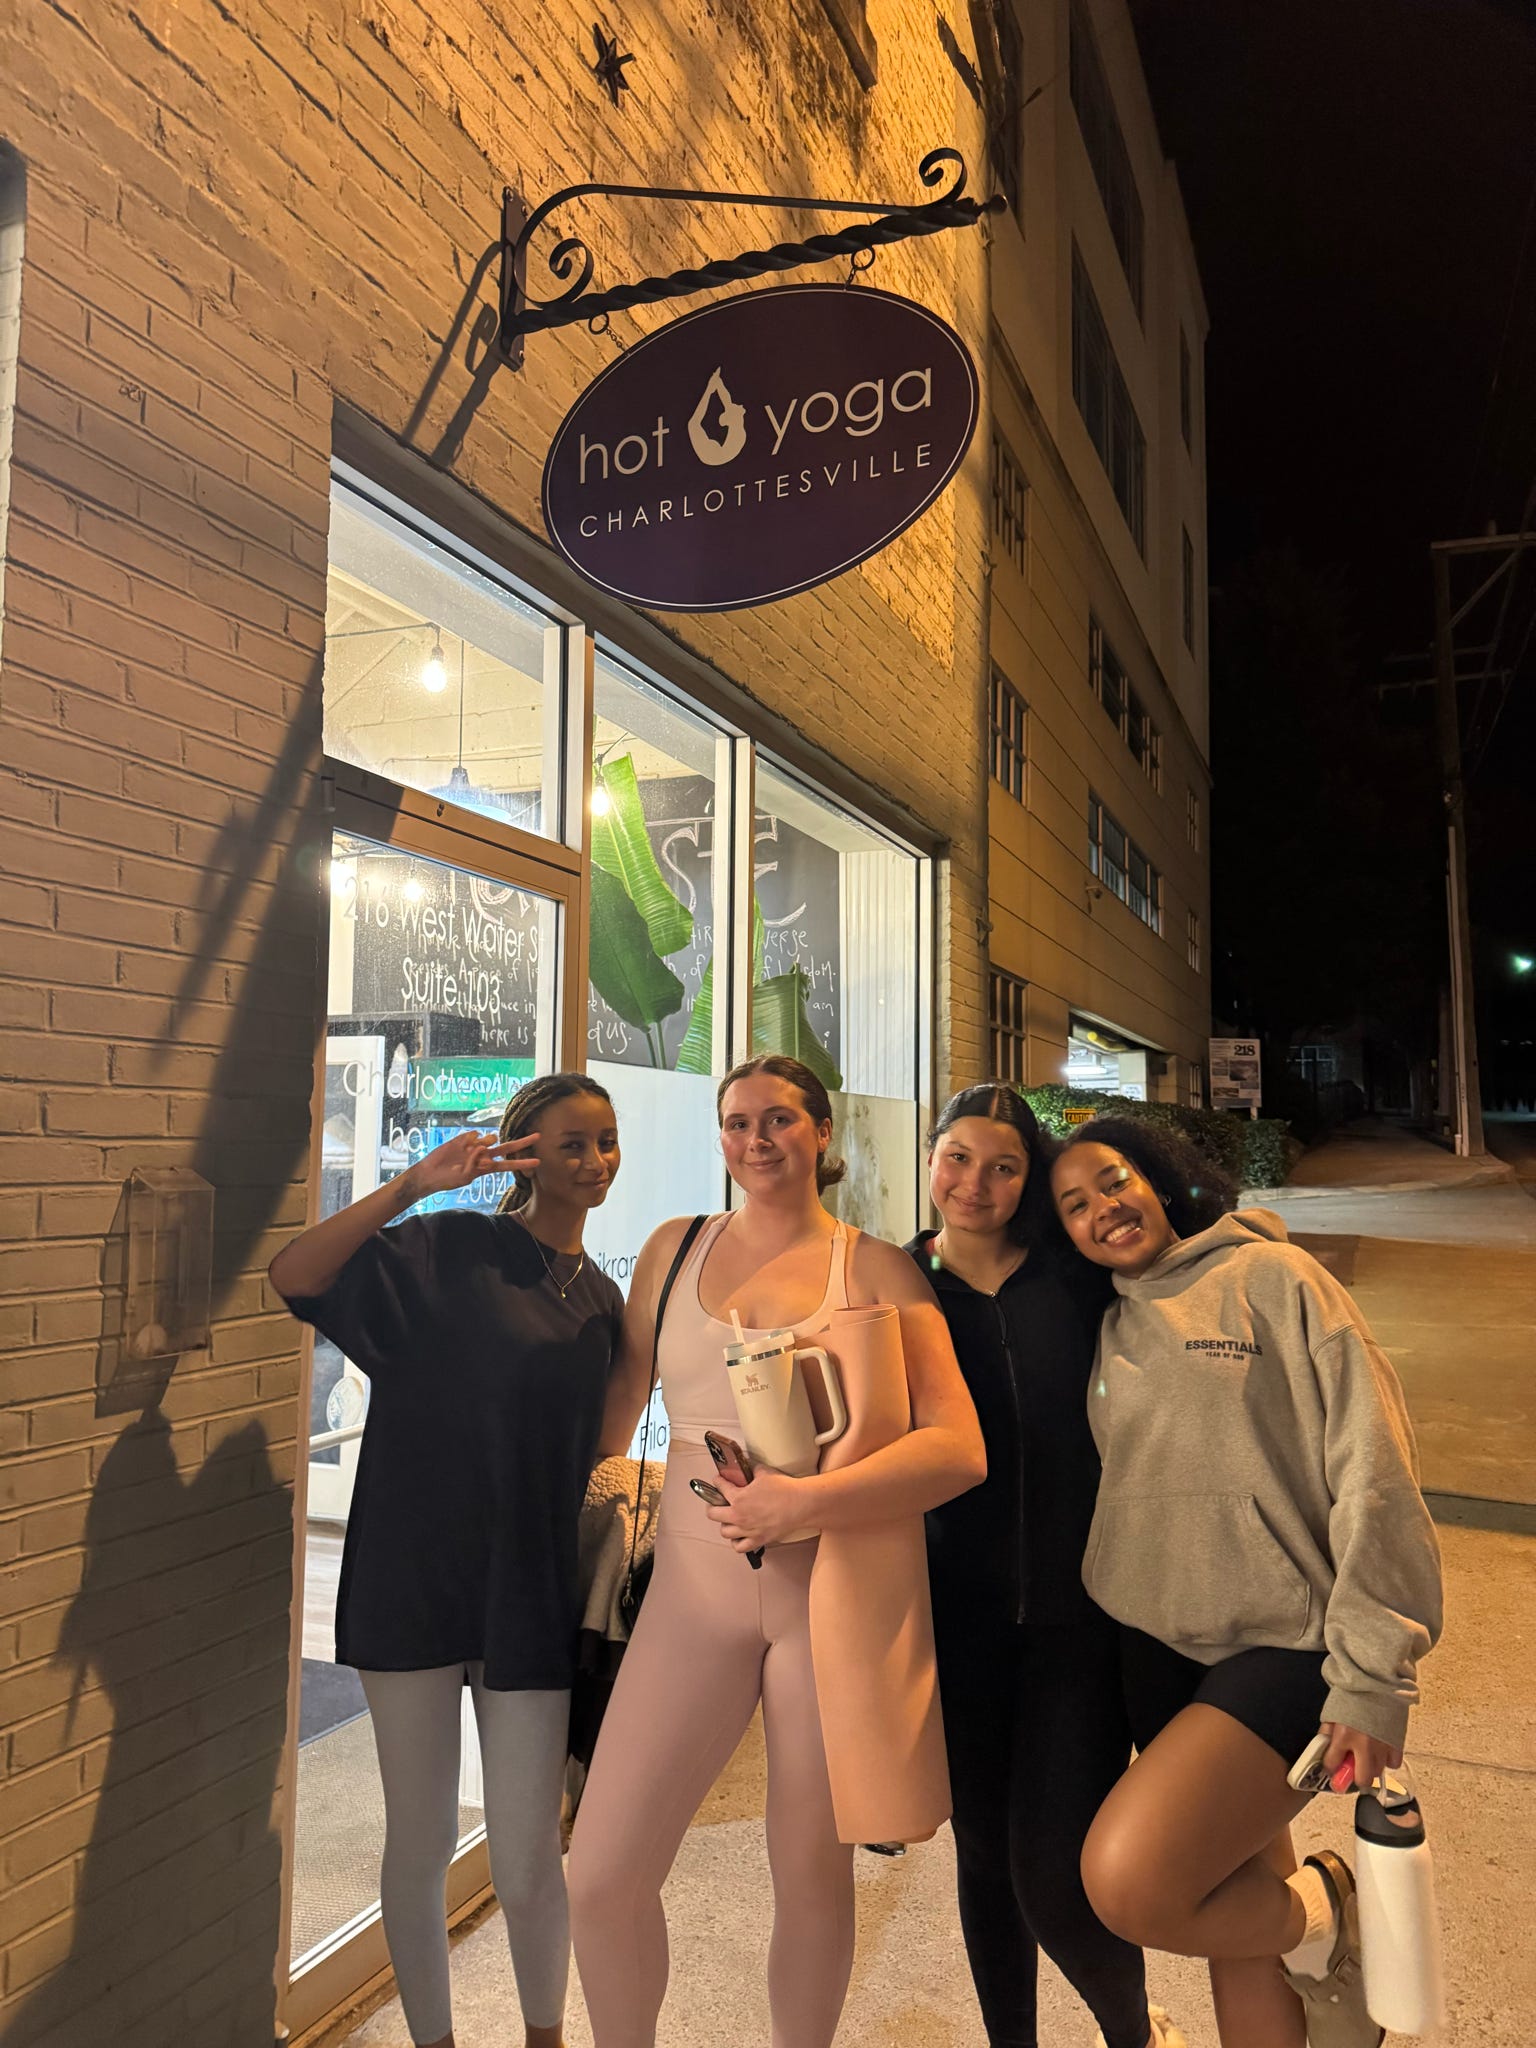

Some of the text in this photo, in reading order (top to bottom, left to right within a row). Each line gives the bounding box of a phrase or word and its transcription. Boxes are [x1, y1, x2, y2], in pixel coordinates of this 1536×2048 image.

[579, 367, 933, 485] hot yoga
[579, 443, 932, 538] CHARLOTTESVILLE
[400, 900, 455, 941] West
[462, 906, 524, 957] Water
[401, 956, 502, 1014] Suite 103
[1233, 1044, 1256, 1057] 218
[389, 1117, 432, 1154] hot
[1185, 1340, 1263, 1356] ESSENTIALS
[740, 1383, 769, 1395] STANLEY
